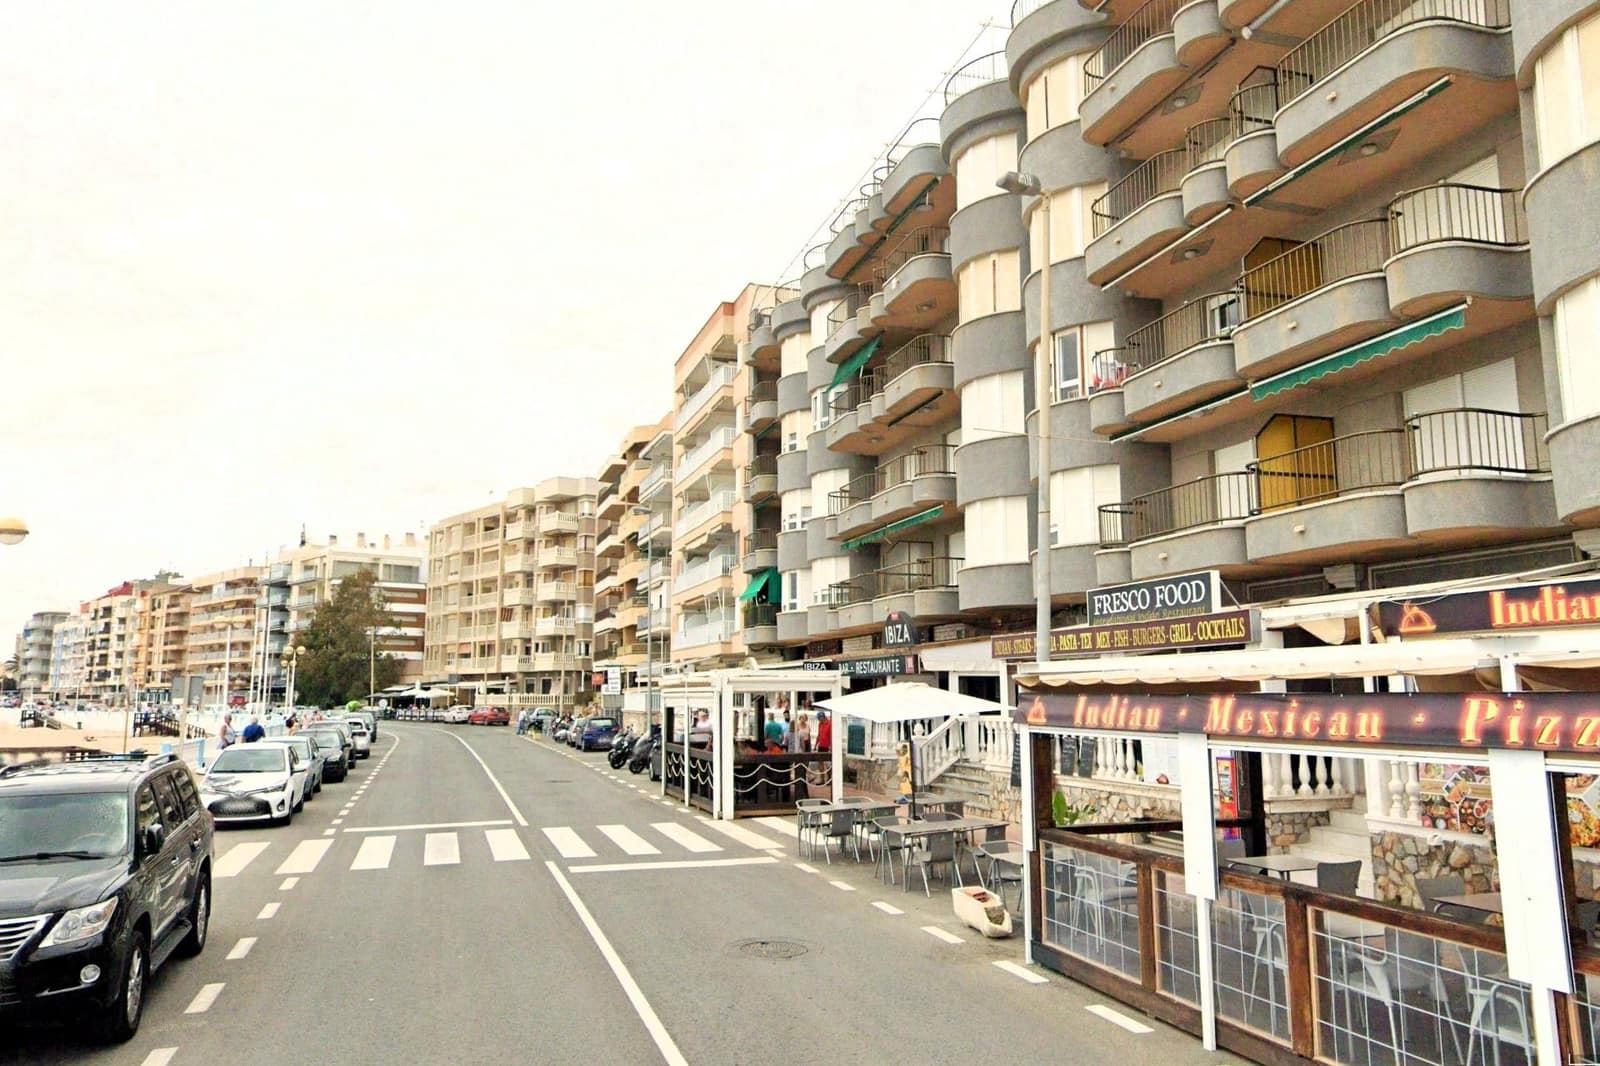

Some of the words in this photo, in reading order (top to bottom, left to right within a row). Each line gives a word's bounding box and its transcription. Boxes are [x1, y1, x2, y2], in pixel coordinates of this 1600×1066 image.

[1093, 588, 1150, 616] FRESCO
[1154, 580, 1206, 608] FOOD
[884, 623, 911, 645] IBIZA
[1059, 634, 1077, 651] PASTA
[1080, 632, 1093, 650] TEX
[1096, 631, 1111, 649] MEX
[1114, 629, 1130, 647] FISH
[1132, 626, 1166, 646] BURGERS
[1169, 622, 1194, 643] GRILL
[1197, 616, 1246, 641] COCKTAILS
[803, 661, 828, 672] IBIZA
[855, 658, 900, 675] RESTAURANTE
[1073, 693, 1162, 729] Indian
[1203, 695, 1382, 740] Mexican
